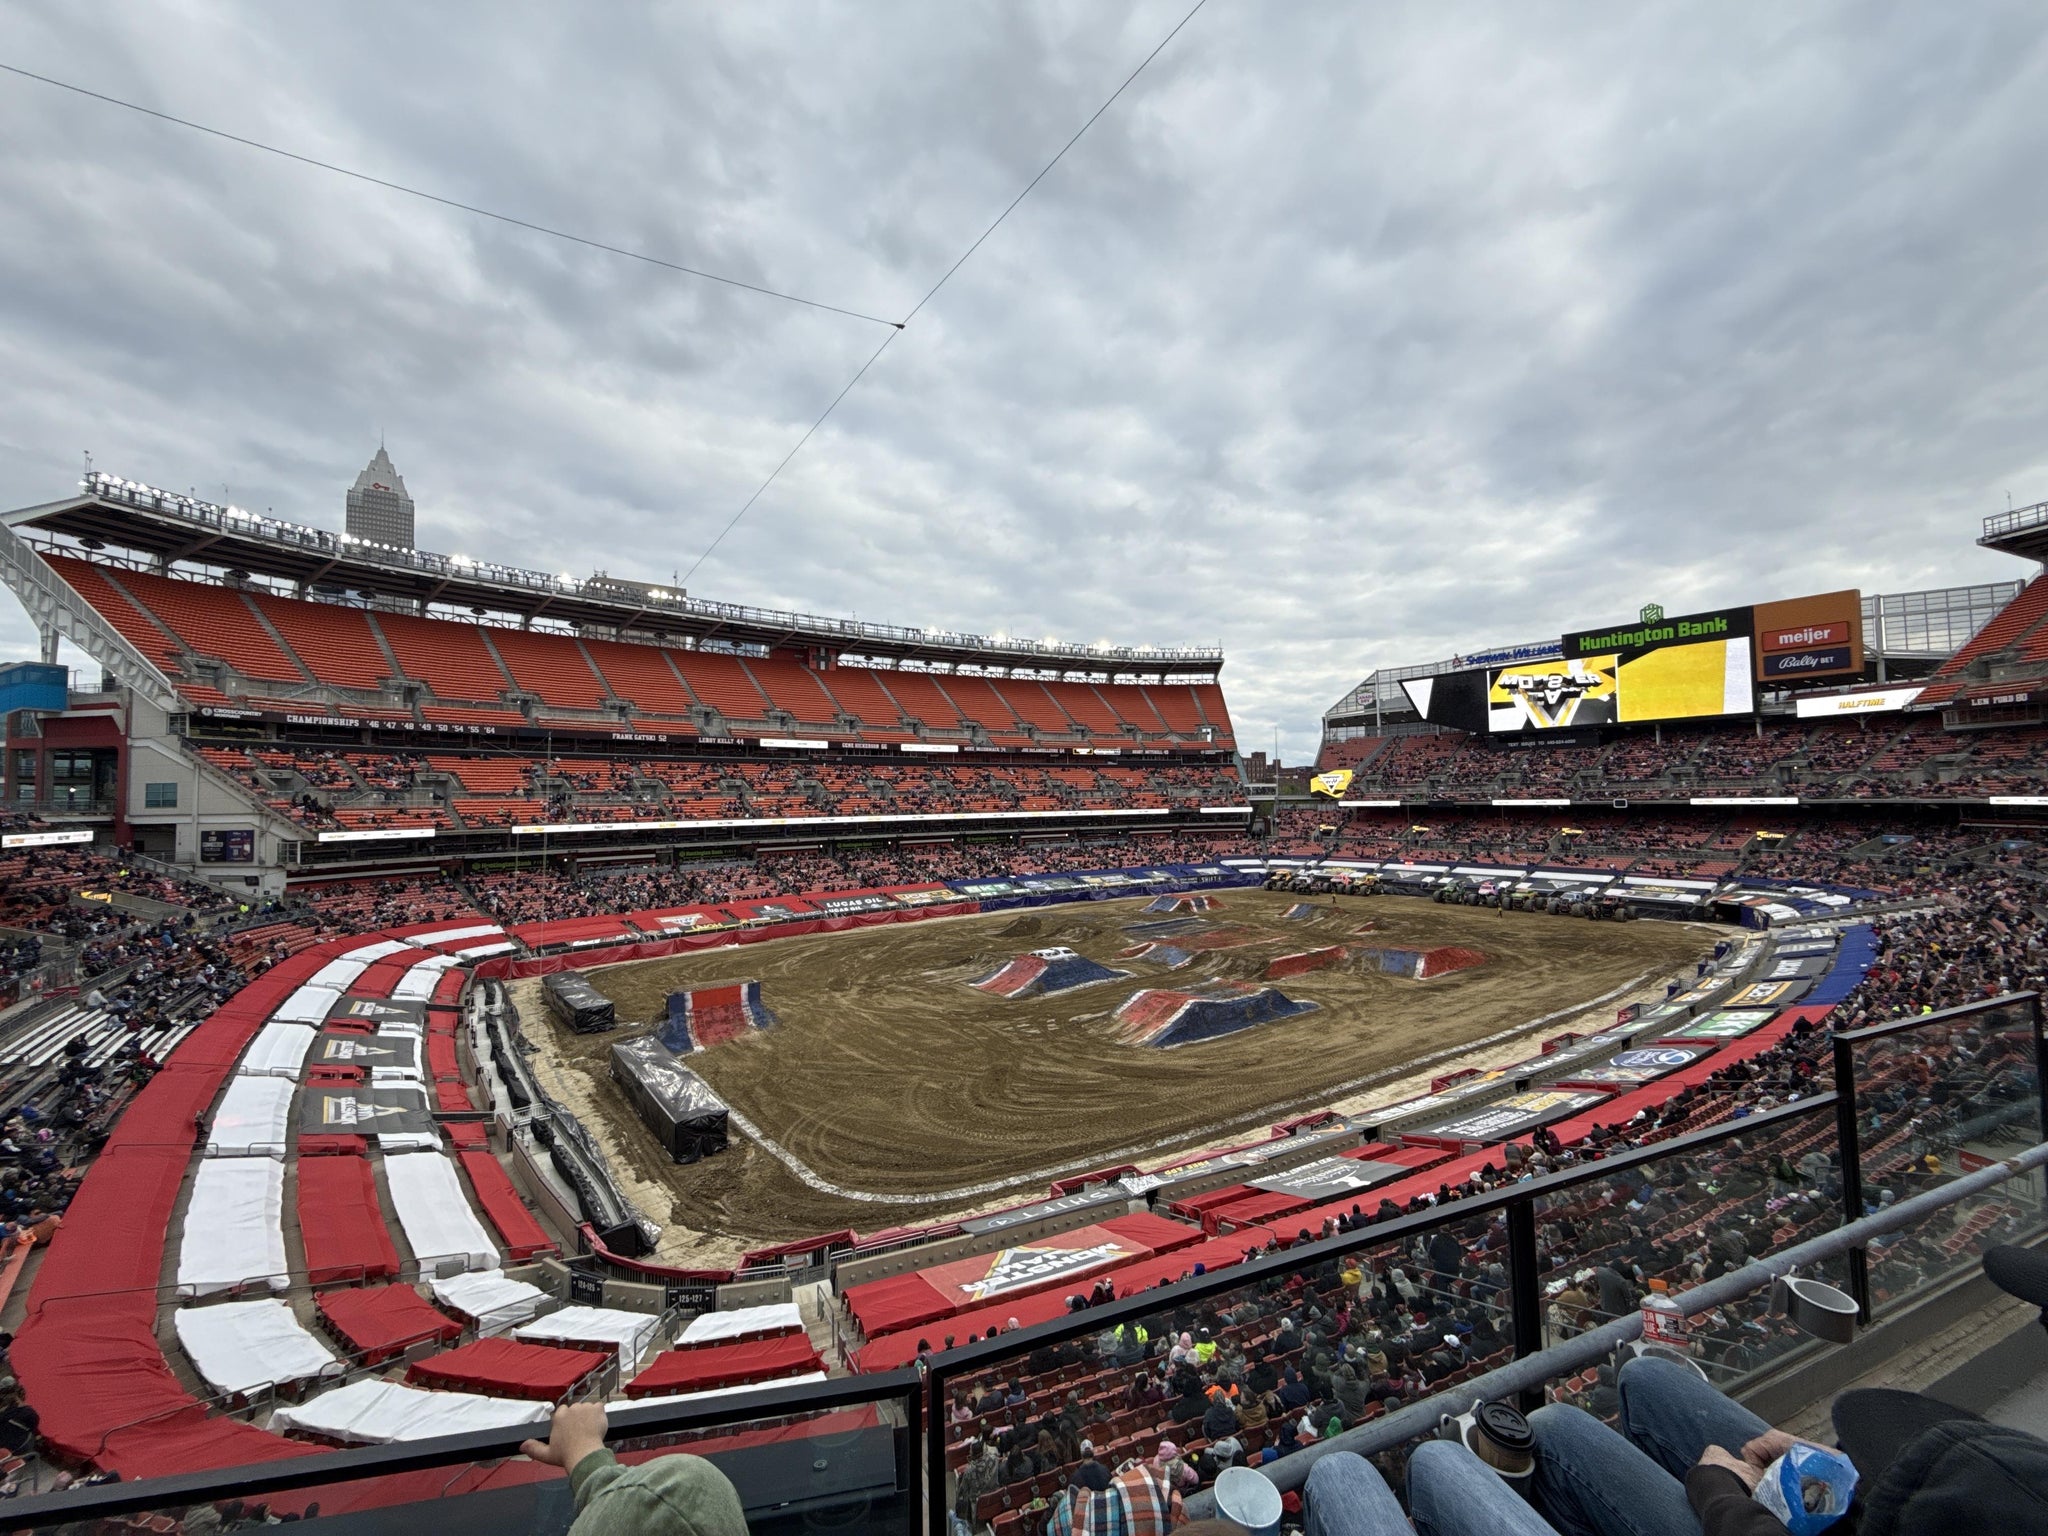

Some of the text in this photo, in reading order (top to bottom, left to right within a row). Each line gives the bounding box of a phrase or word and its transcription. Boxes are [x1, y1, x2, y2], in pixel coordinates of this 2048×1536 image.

[1578, 616, 1728, 652] Huntington Bank
[1778, 627, 1831, 645] meijer
[1778, 654, 1834, 669] Bally BET
[1838, 697, 1887, 710] HALFTIME
[1970, 696, 1990, 706] LEN
[1992, 694, 2014, 705] FORD
[286, 714, 496, 735] CHAMPIONSHIPS '46 '47 '48 '49 '50 '54 '55 '64
[612, 732, 634, 741] FRANK
[658, 734, 667, 743] 52
[717, 737, 734, 745] KELLY
[736, 738, 745, 746] 44
[826, 897, 884, 909] LUCAS OIL
[1164, 1165, 1184, 1176] APP
[1022, 1190, 1110, 1220] SHIFT
[958, 1242, 1123, 1293] MONSTER
[993, 1249, 1062, 1276] JAM
[678, 1293, 703, 1303] 125-127
